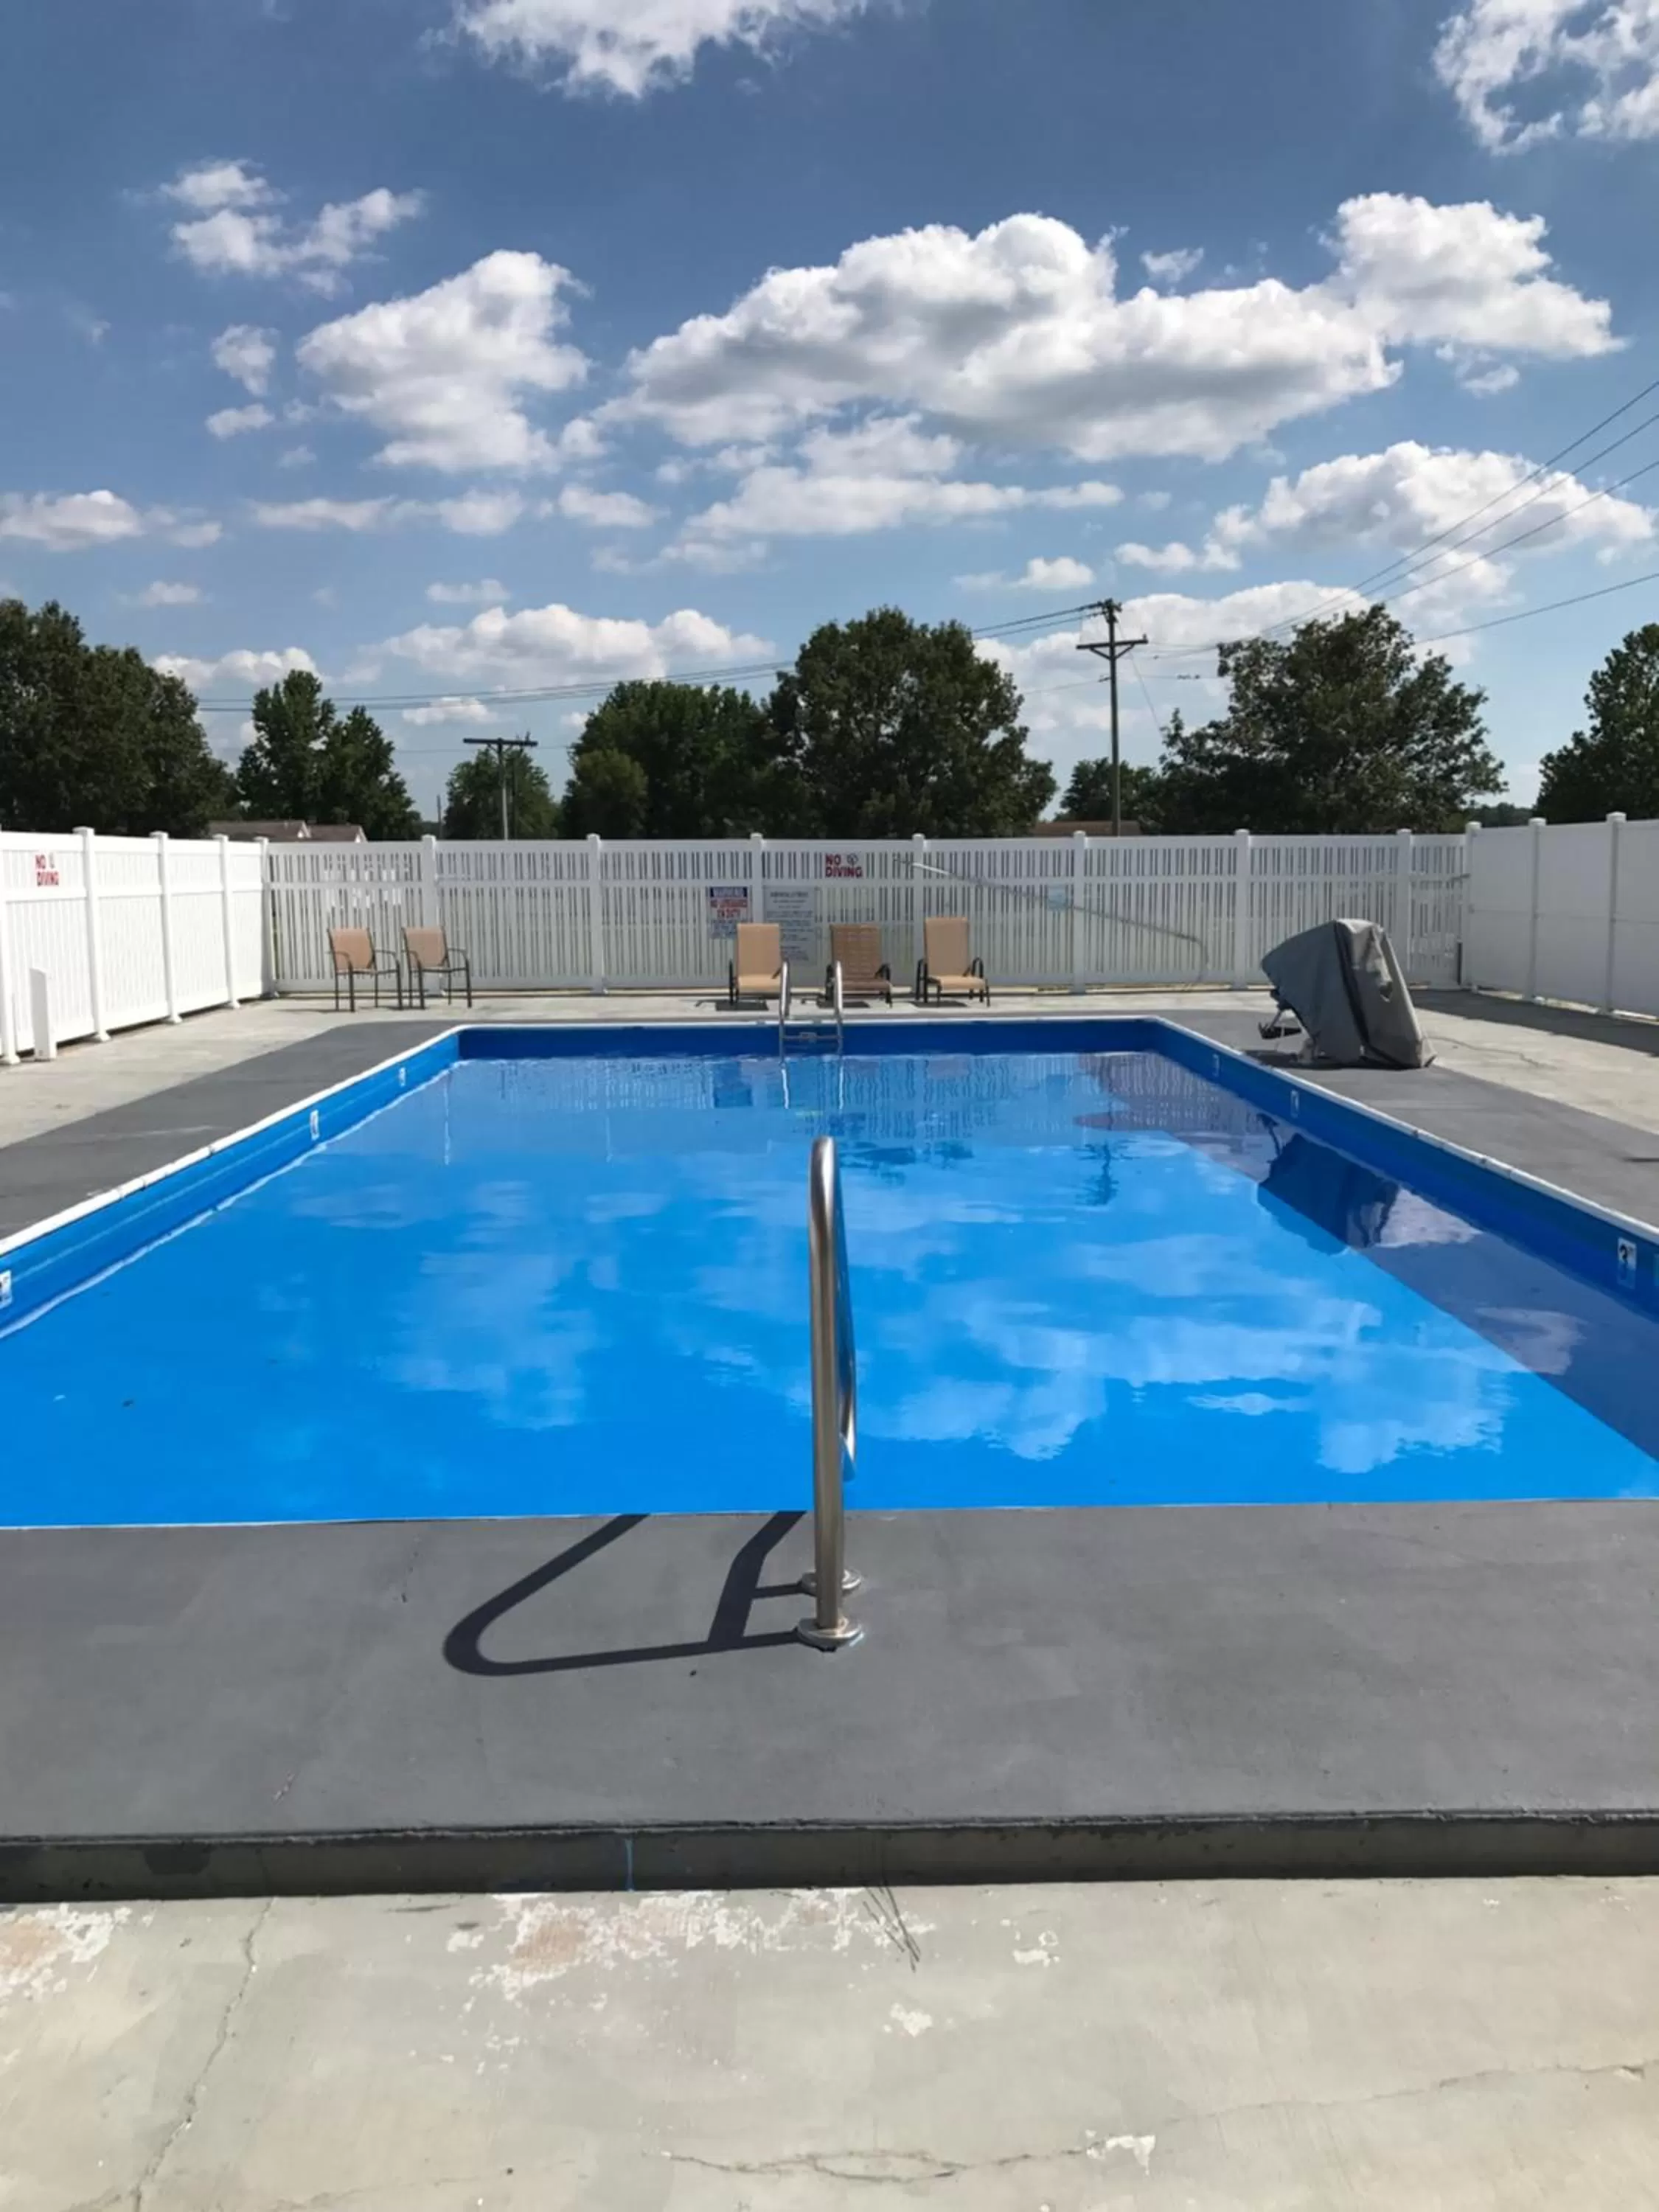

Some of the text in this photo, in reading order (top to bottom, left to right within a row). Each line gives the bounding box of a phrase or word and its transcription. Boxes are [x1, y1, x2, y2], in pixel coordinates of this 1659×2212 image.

[35, 854, 46, 869] NO
[826, 853, 841, 866] NO
[826, 866, 863, 877] DIVING
